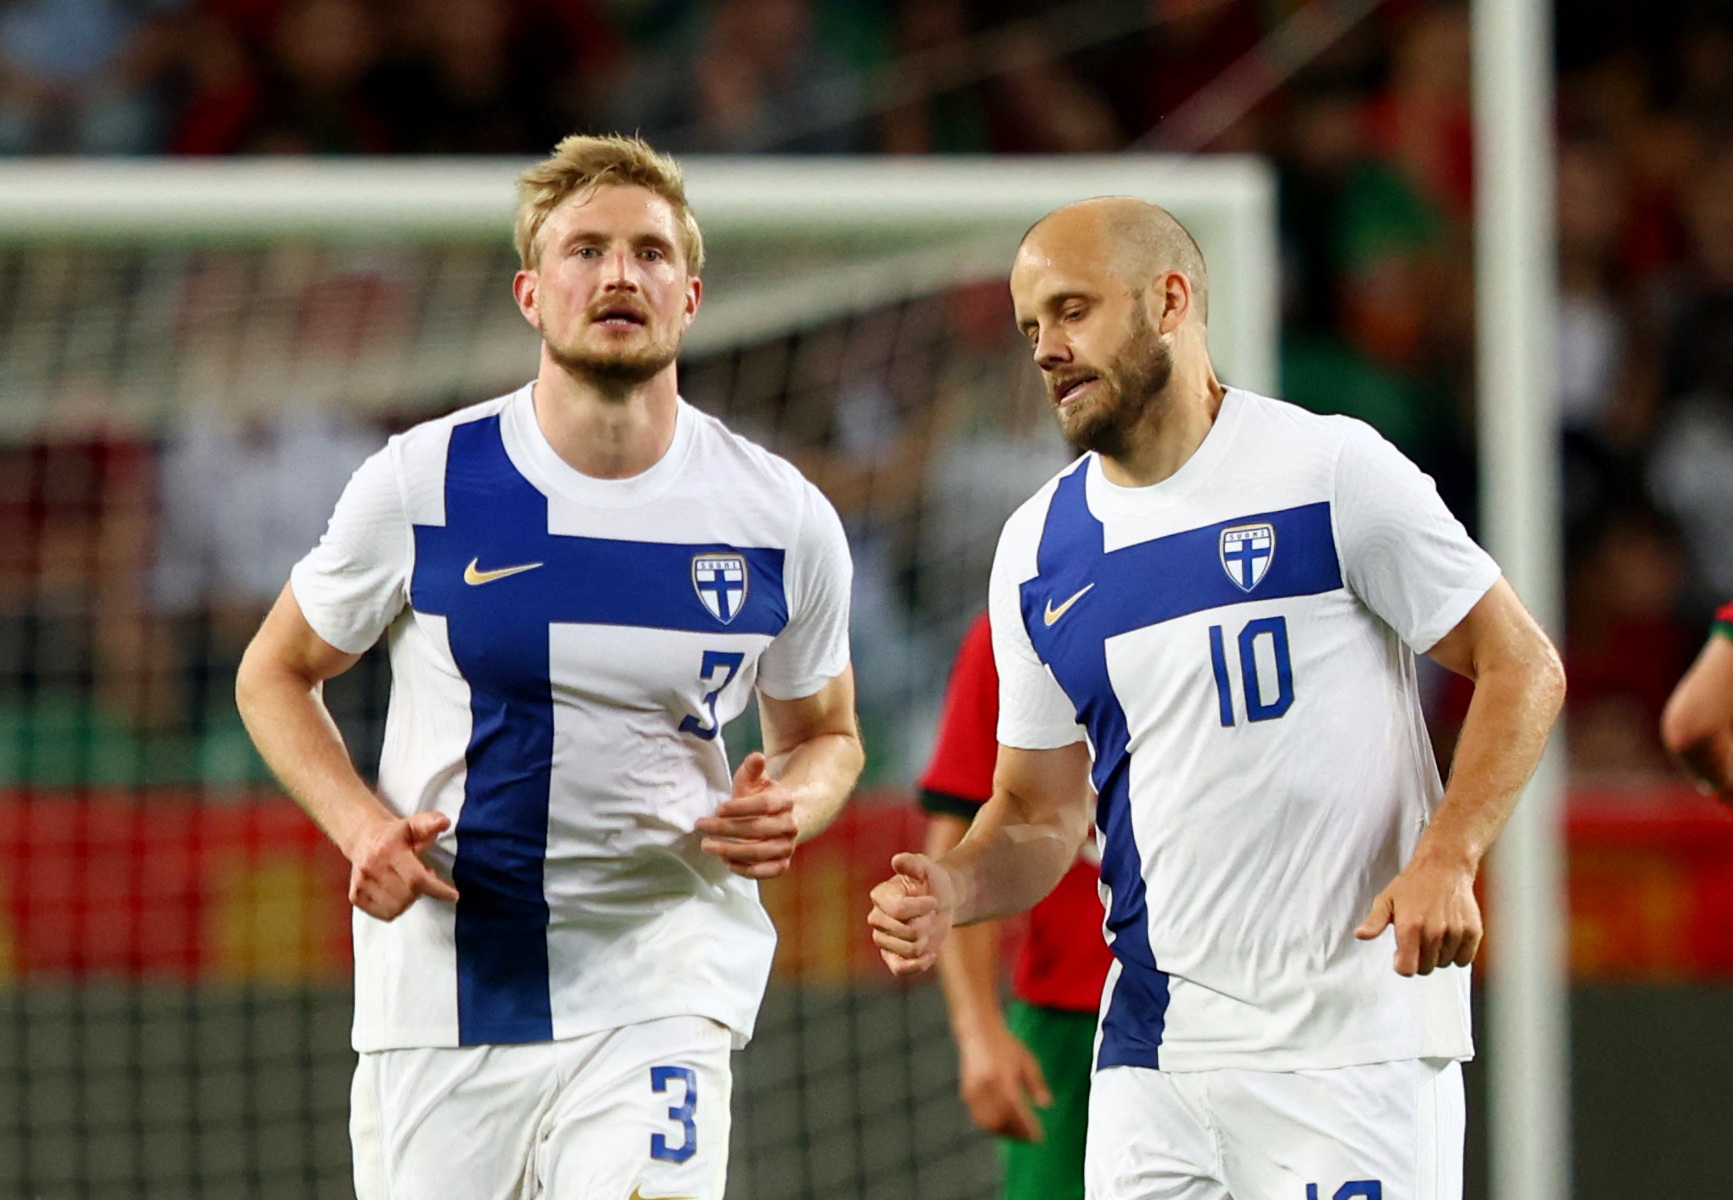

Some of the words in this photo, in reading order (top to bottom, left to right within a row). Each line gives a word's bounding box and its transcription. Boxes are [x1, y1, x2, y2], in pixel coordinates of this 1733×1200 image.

[1229, 530, 1265, 540] SUOMI
[678, 650, 745, 741] 3
[1209, 615, 1295, 728] 10
[650, 1066, 697, 1165] 3
